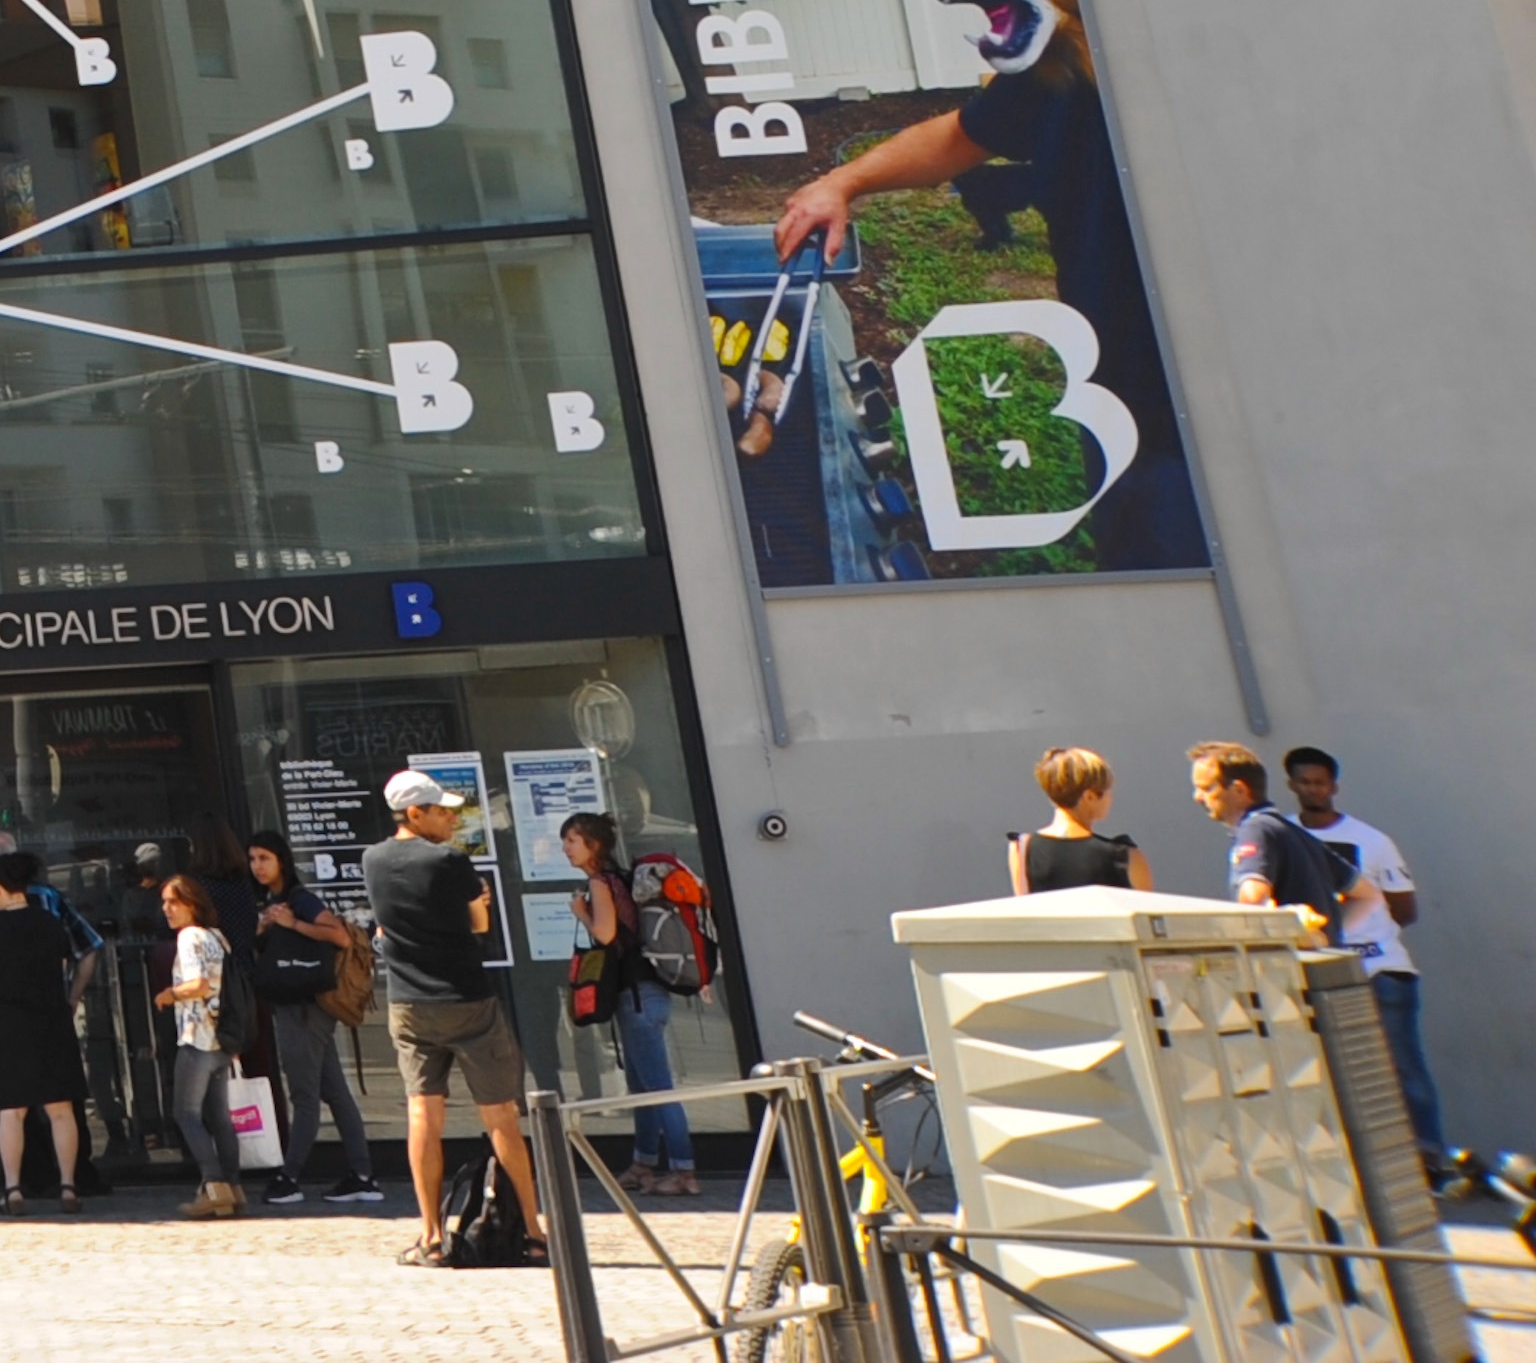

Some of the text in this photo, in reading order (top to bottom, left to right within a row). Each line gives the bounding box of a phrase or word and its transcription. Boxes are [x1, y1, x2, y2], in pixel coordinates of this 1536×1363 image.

[76, 37, 117, 86] B
[359, 30, 455, 132] B
[345, 139, 374, 171] B
[388, 340, 473, 434] B
[547, 391, 605, 452] B
[892, 299, 1139, 550] B
[314, 441, 344, 473] B
[151, 603, 213, 641] DE
[220, 595, 336, 635] LYON
[393, 581, 442, 639] B
[303, 769, 344, 778] Part-Dieu
[314, 813, 336, 821] Lyon
[314, 853, 338, 881] B
